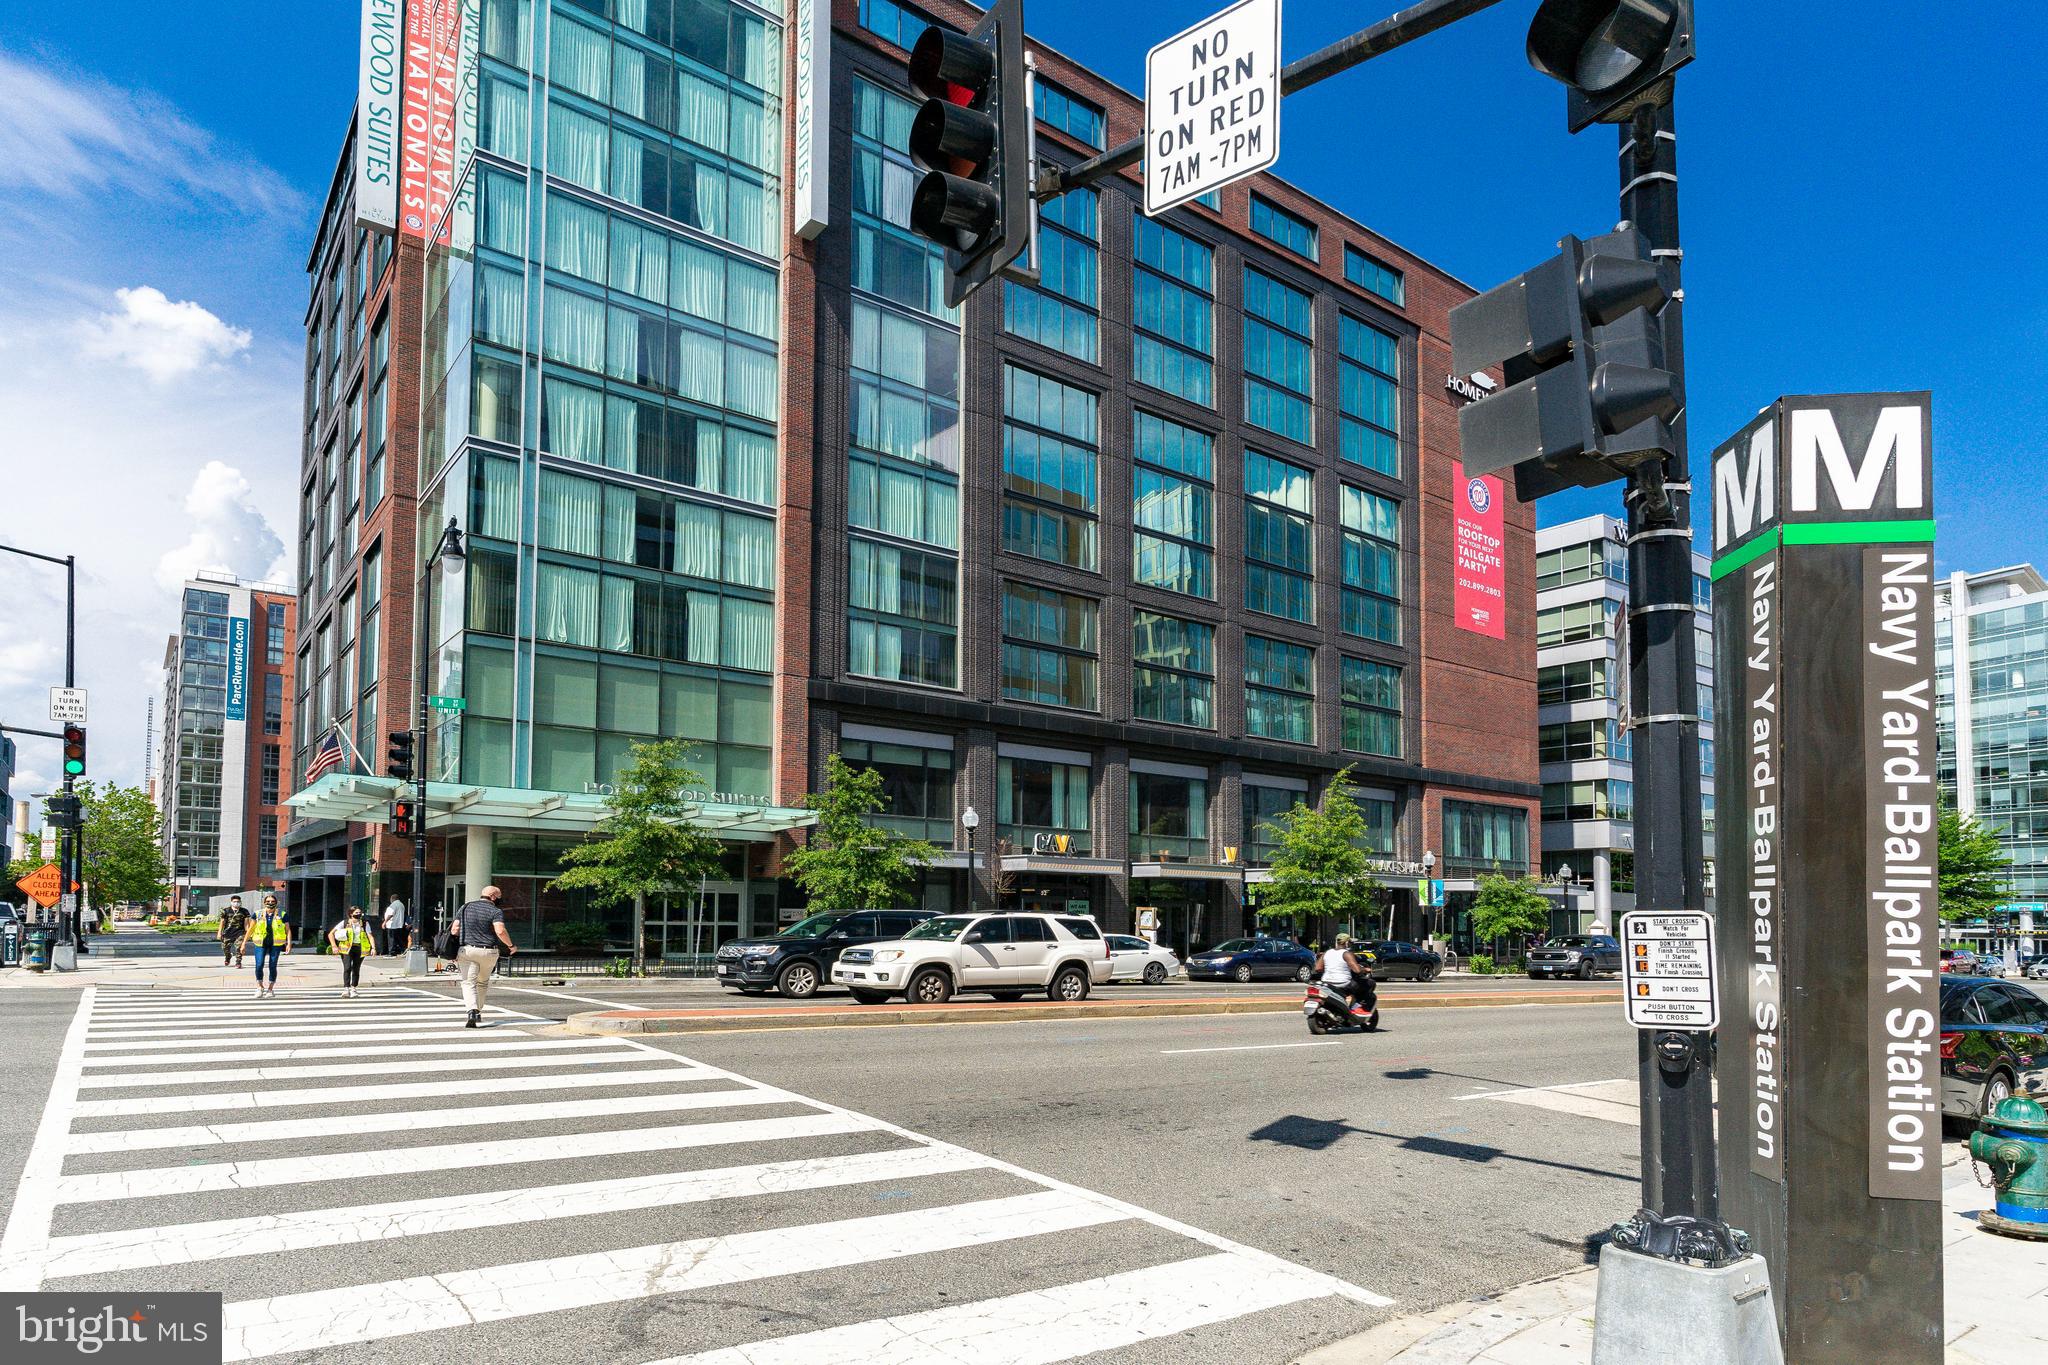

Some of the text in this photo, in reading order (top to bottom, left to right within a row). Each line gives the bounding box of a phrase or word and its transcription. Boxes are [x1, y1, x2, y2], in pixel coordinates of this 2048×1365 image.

[410, 3, 419, 36] OF THE
[1192, 29, 1228, 70] NO
[1170, 51, 1254, 115] TURN
[405, 41, 429, 210] NATIONALS
[1158, 87, 1264, 157] ON RED
[367, 102, 392, 186] SUITES
[798, 105, 810, 190] SUITES
[1792, 406, 1923, 511] M
[1716, 419, 1774, 551] M
[1458, 526, 1500, 548] ROOFTOP
[1458, 545, 1500, 567] TAILGATE
[1459, 557, 1487, 574] PARTY
[1460, 578, 1501, 598] 202.899.2803
[232, 621, 244, 704] ParcRiverside.com
[438, 698, 444, 706] M
[710, 792, 771, 807] SUITES
[398, 820, 406, 833] 14
[1034, 832, 1077, 854] CAVA
[1397, 862, 1424, 874] SHAC
[1748, 561, 1779, 1159] Navy Yard-Ballpark Station
[1870, 554, 1934, 1171] Navy Yard-Ballpark Station
